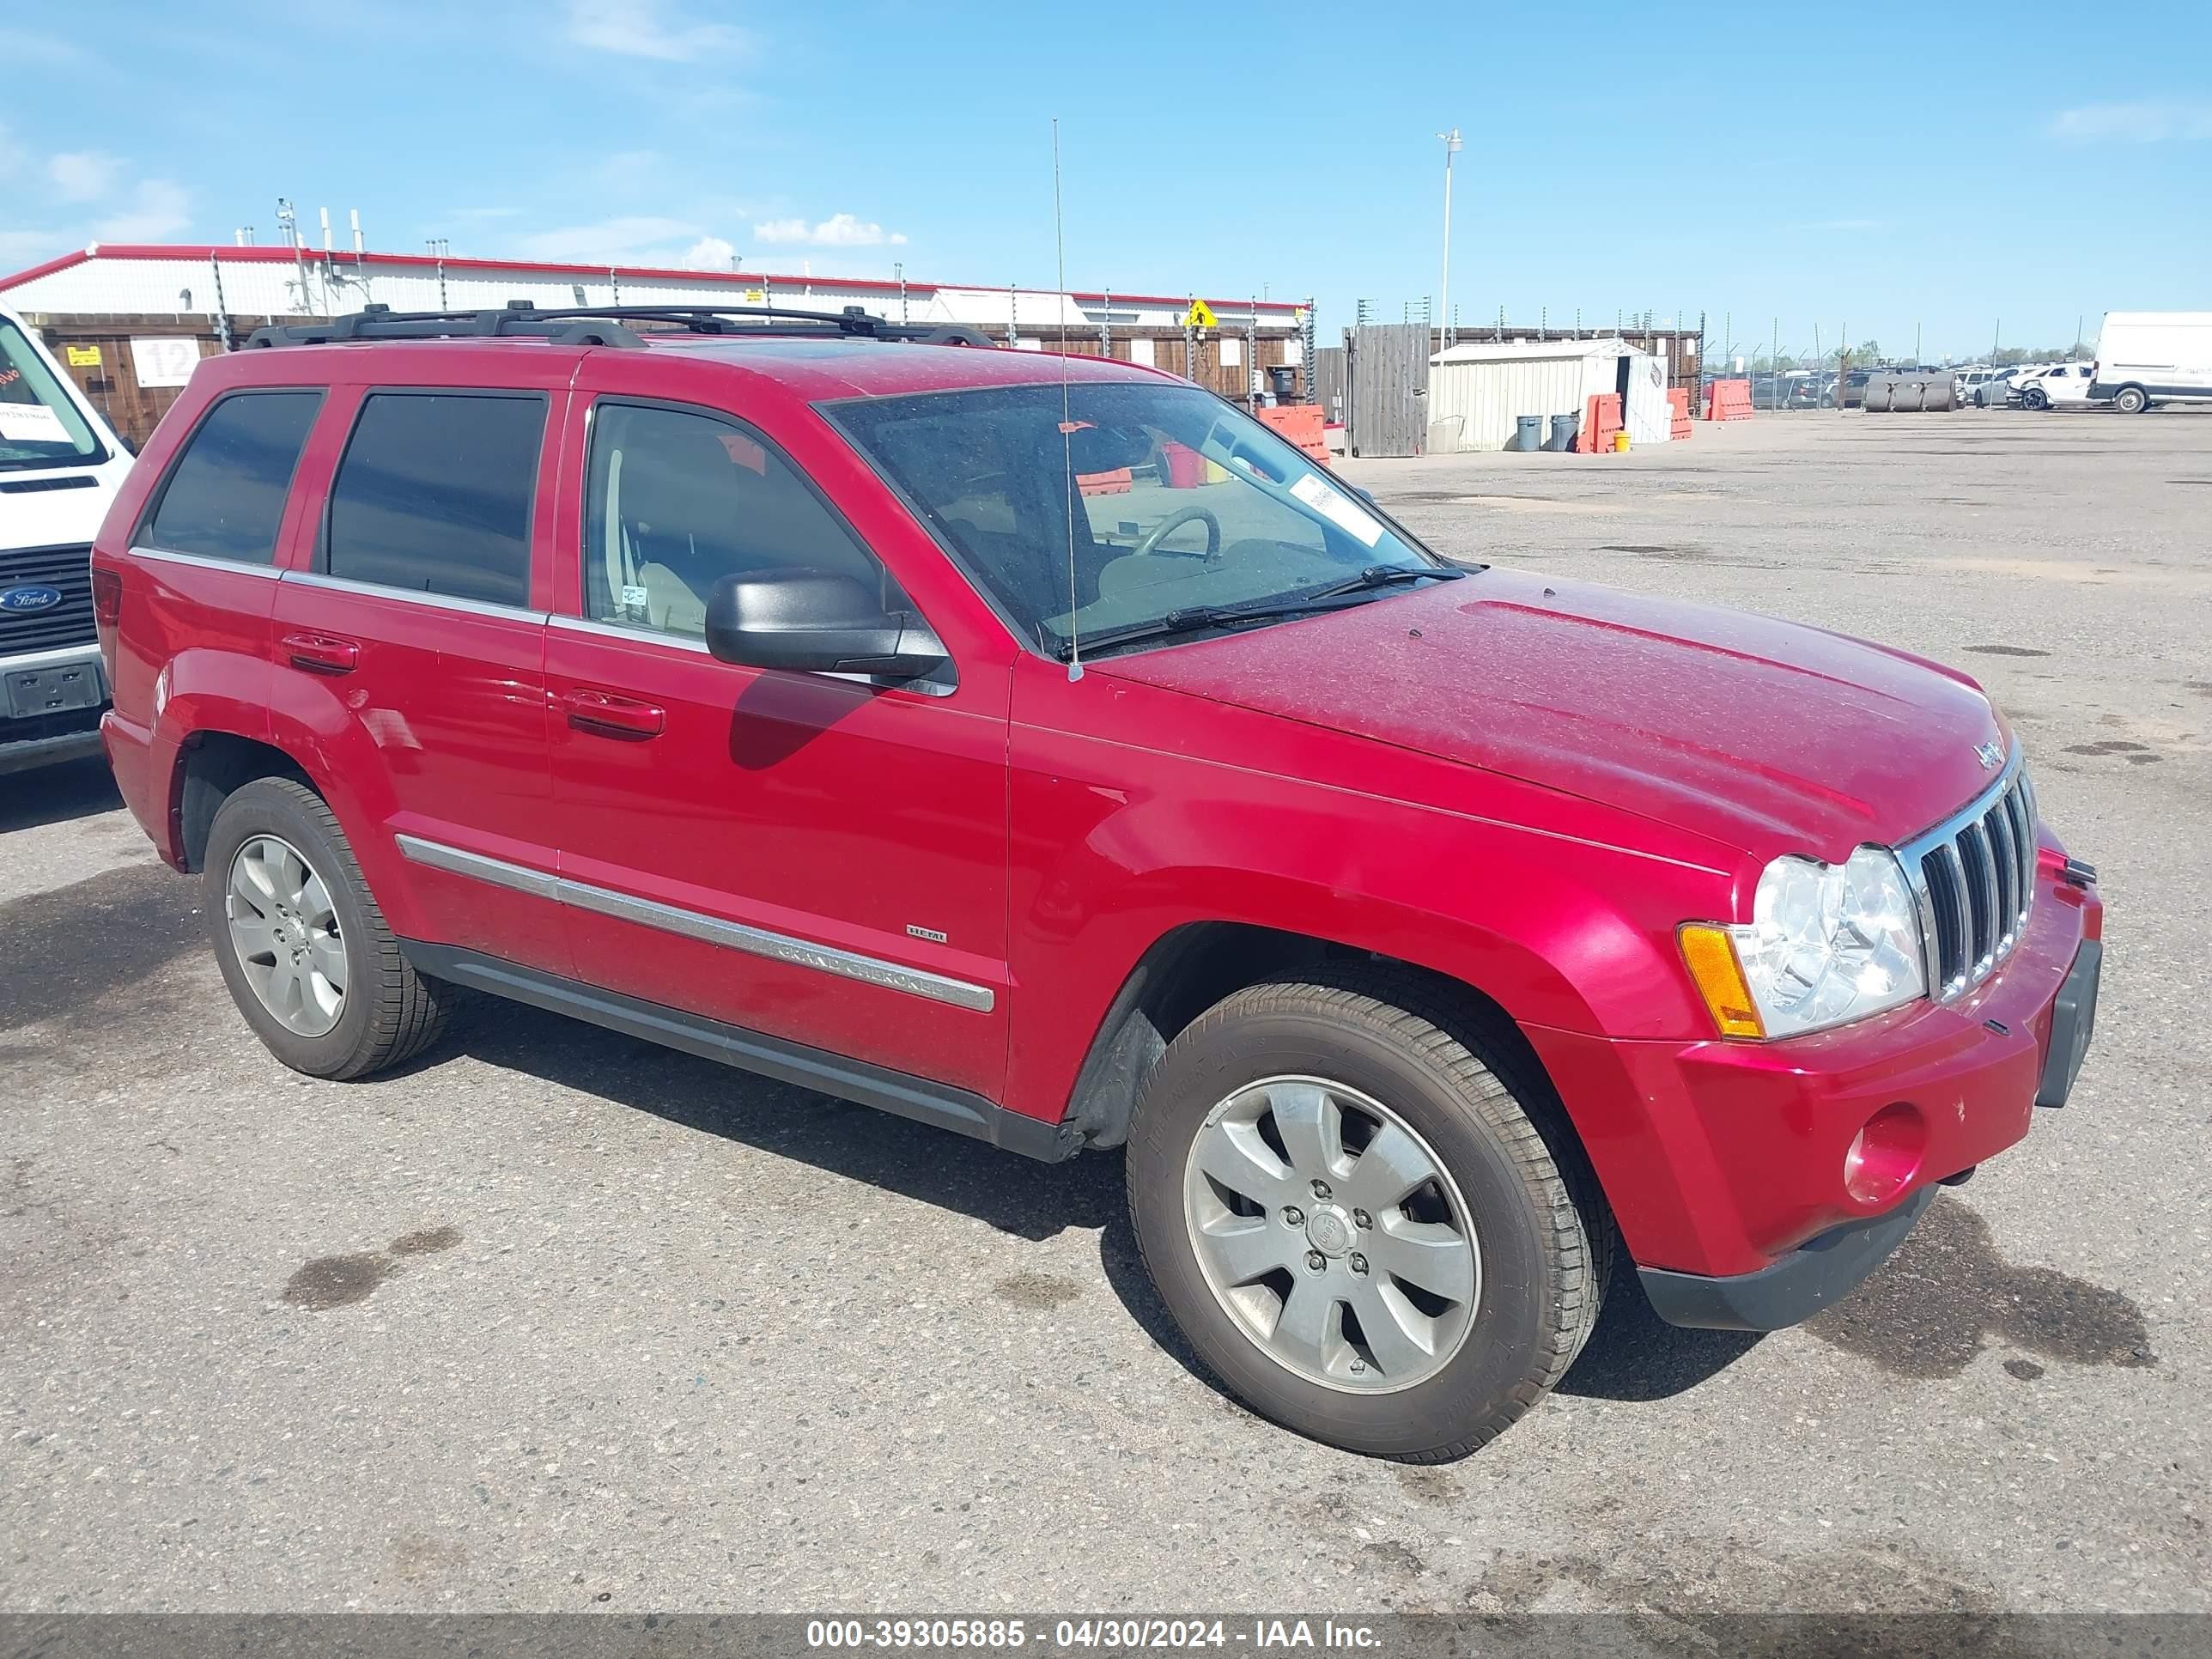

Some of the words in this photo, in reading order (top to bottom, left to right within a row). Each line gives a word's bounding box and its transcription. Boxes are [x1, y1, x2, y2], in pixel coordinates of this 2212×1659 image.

[146, 343, 191, 377] 12
[14, 592, 48, 607] Ford
[908, 927, 945, 941] HEMI
[779, 946, 840, 969] GRAND
[846, 963, 944, 996] CHEROKEE
[1318, 1219, 1336, 1244] Jeep
